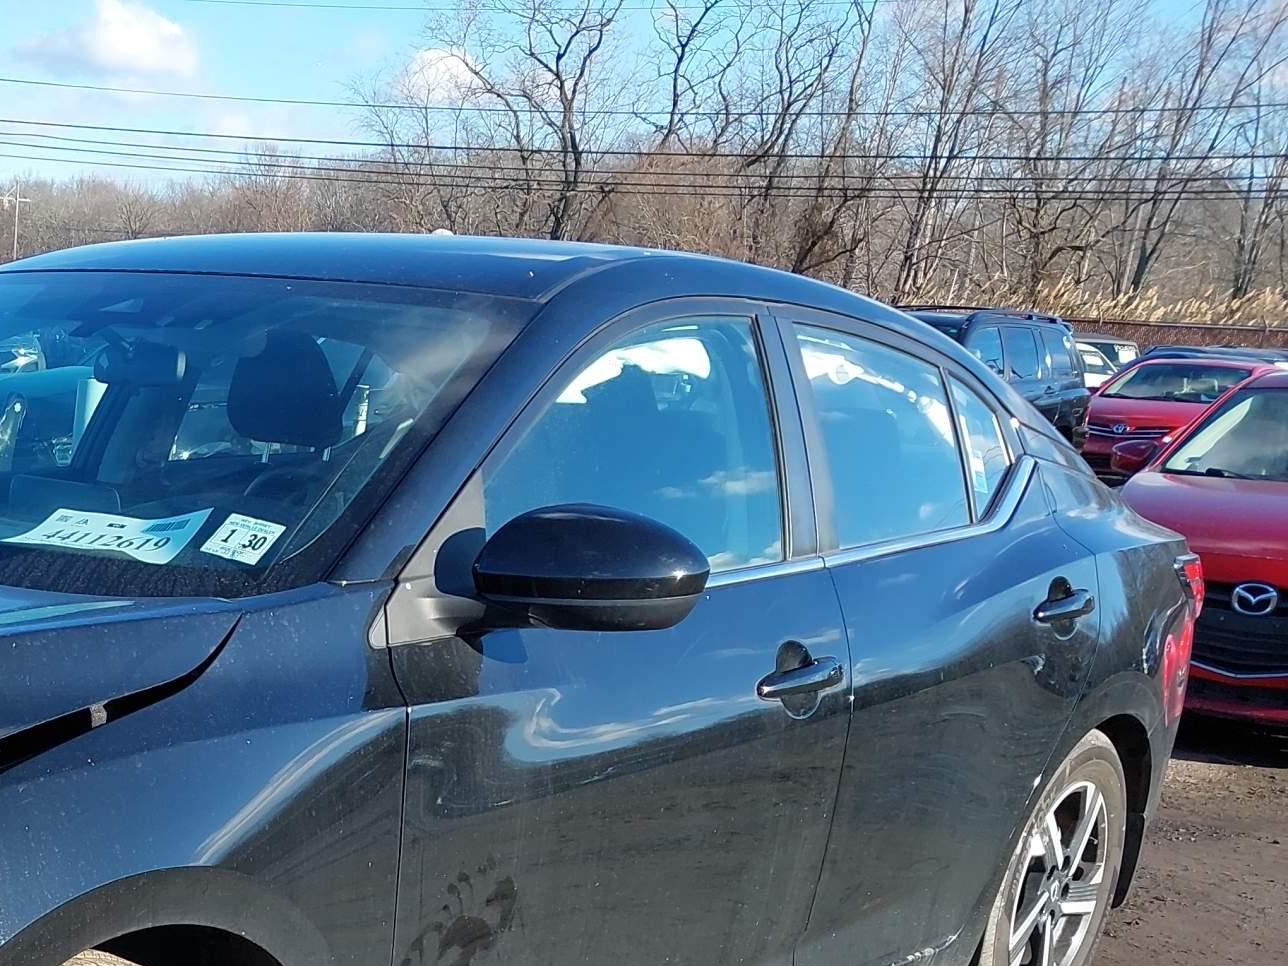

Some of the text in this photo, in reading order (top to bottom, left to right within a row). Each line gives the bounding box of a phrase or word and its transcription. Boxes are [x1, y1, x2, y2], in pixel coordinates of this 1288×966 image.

[43, 529, 171, 551] 44112619
[221, 528, 268, 551] 1 30
